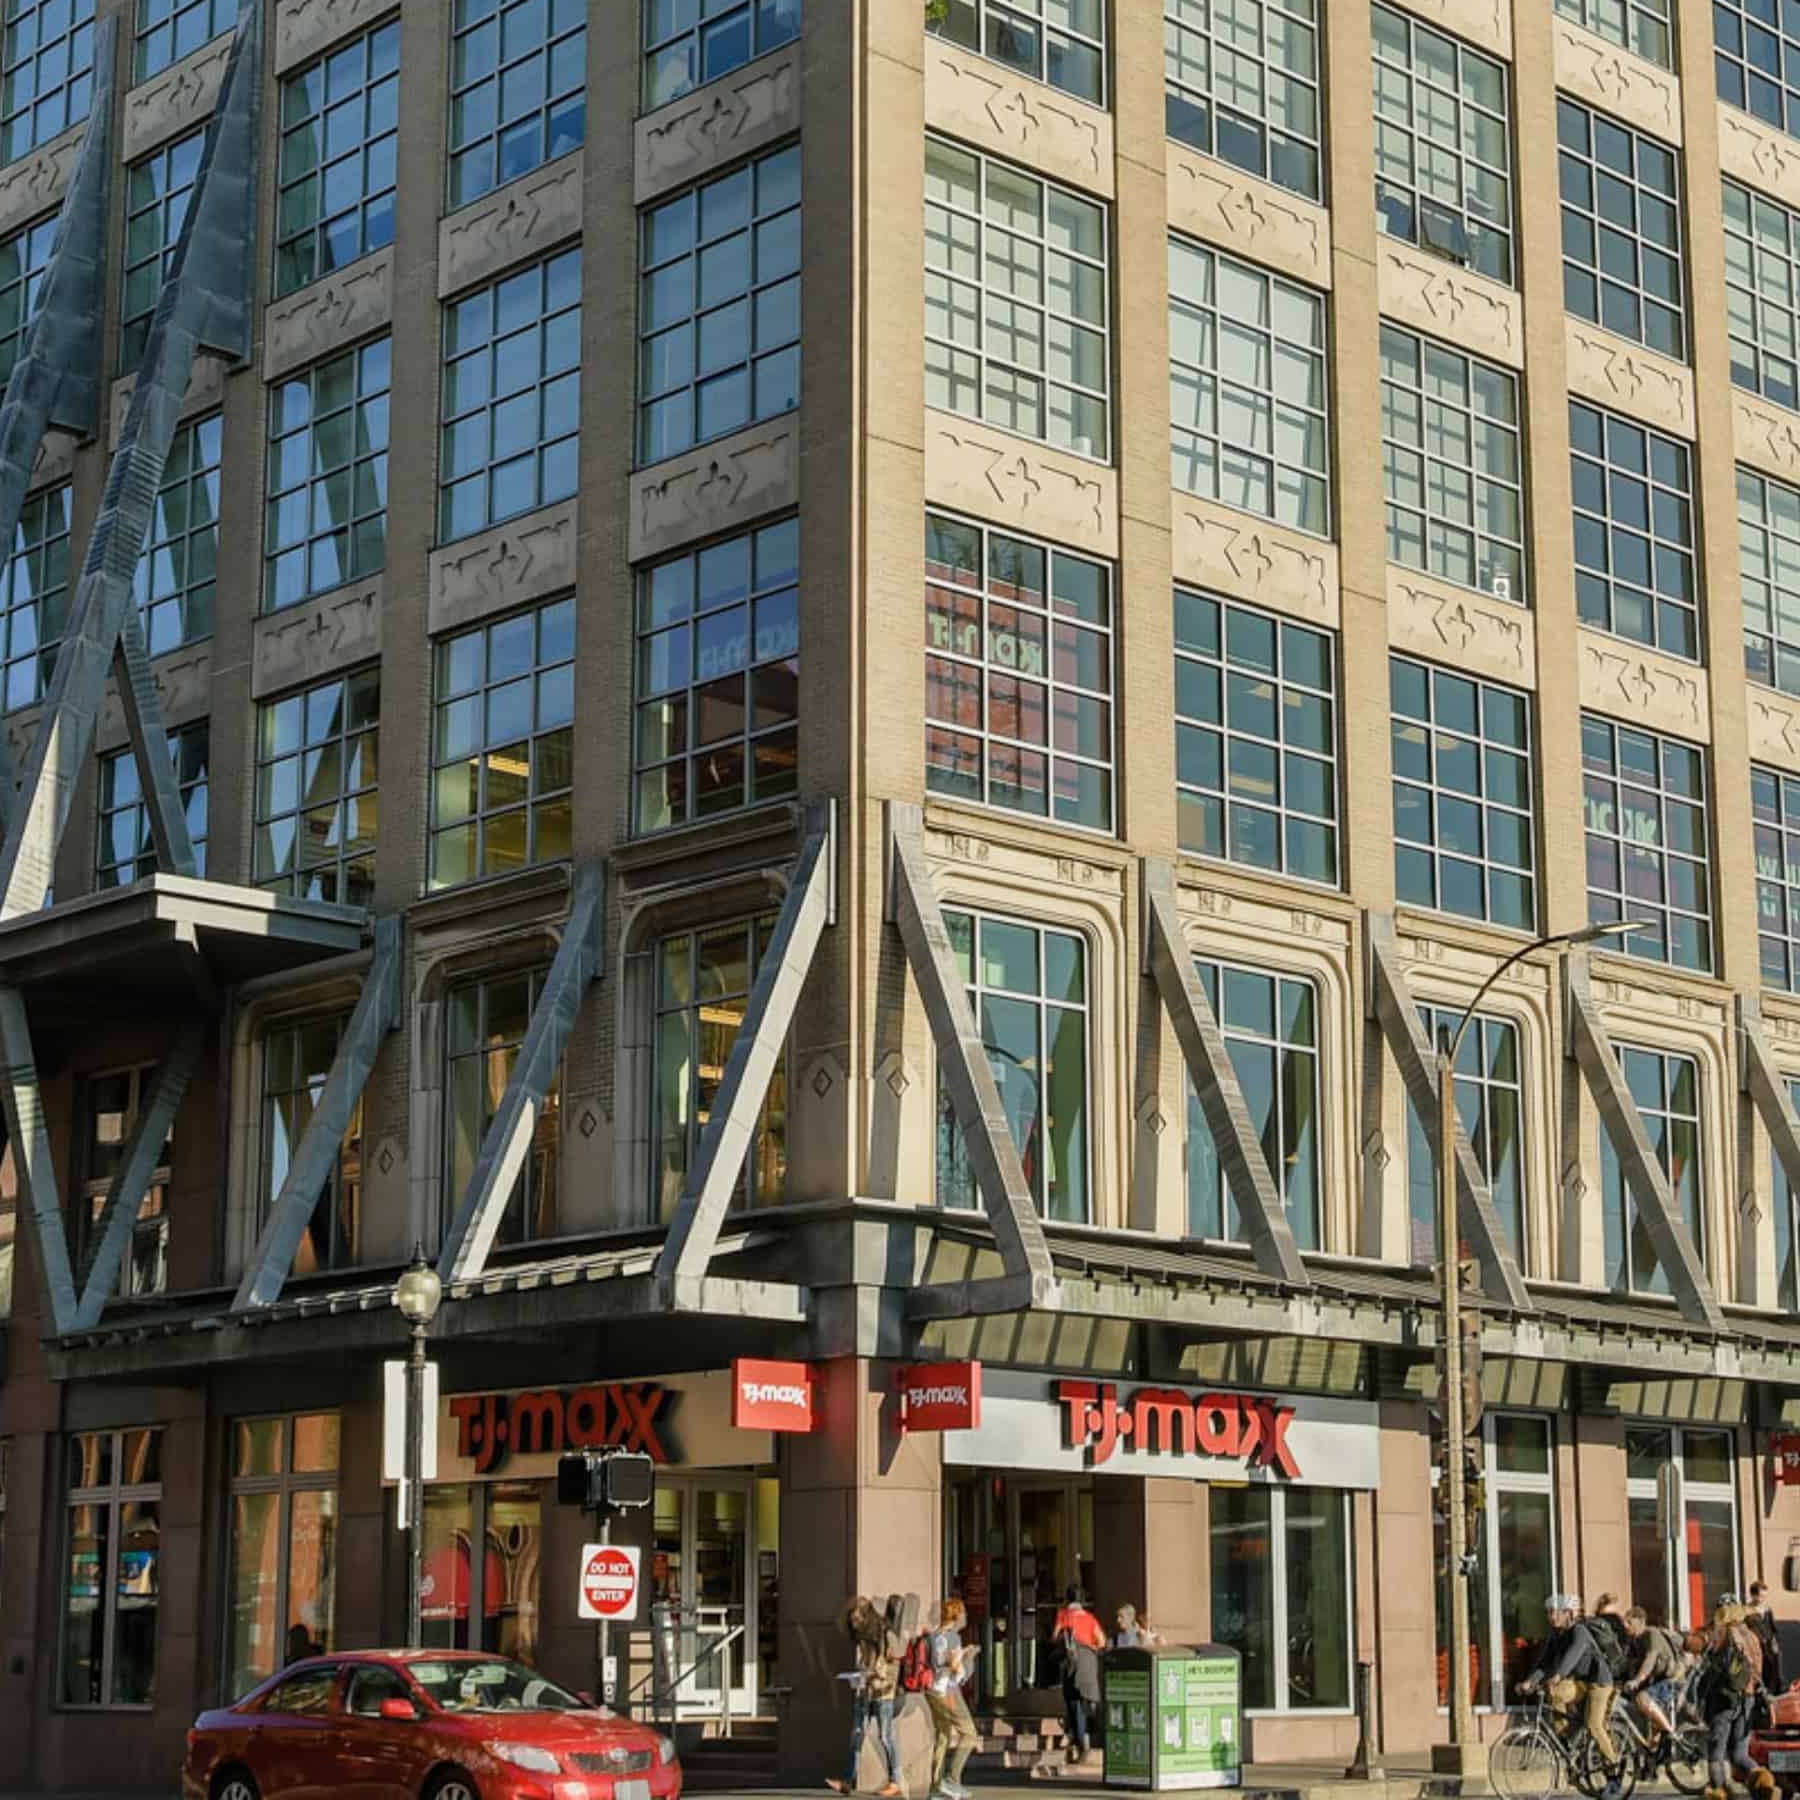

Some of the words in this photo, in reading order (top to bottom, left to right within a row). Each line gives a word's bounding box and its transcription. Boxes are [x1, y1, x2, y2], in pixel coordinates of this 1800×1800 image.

[591, 1562, 607, 1574] DO
[609, 1562, 630, 1574] NOT
[591, 1590, 626, 1602] ENTER
